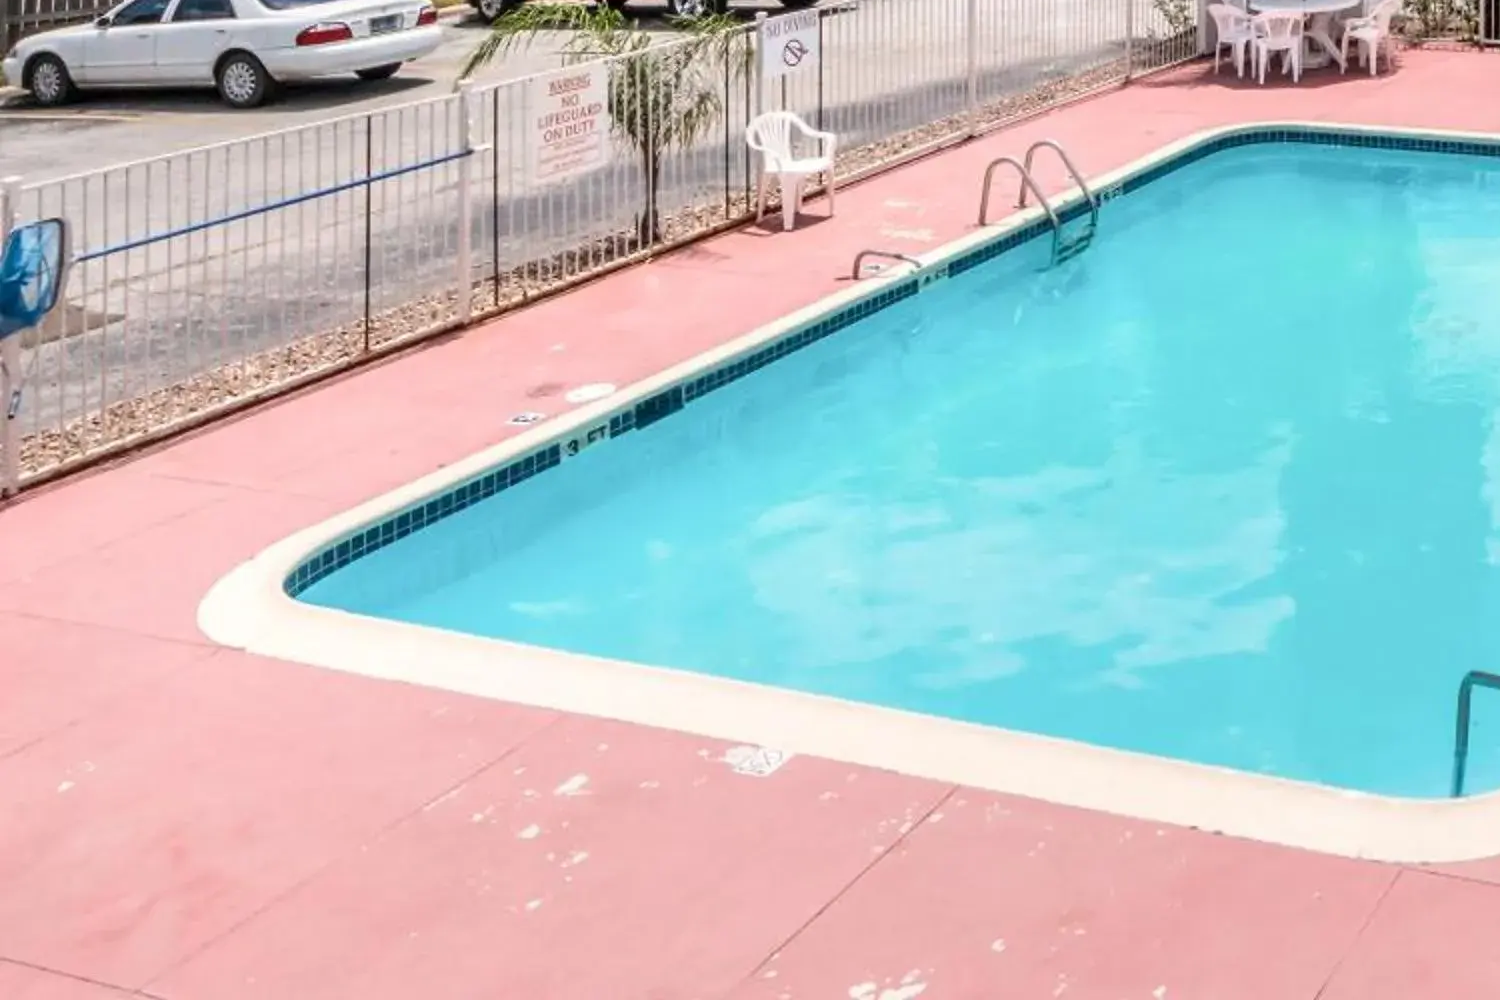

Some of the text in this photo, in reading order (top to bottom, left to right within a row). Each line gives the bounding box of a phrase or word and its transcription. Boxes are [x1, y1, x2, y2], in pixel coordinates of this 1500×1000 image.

[561, 94, 579, 107] NO
[538, 102, 603, 130] LIFEGUARD
[543, 119, 595, 143] ON DUTY
[567, 424, 607, 457] 3 FT
